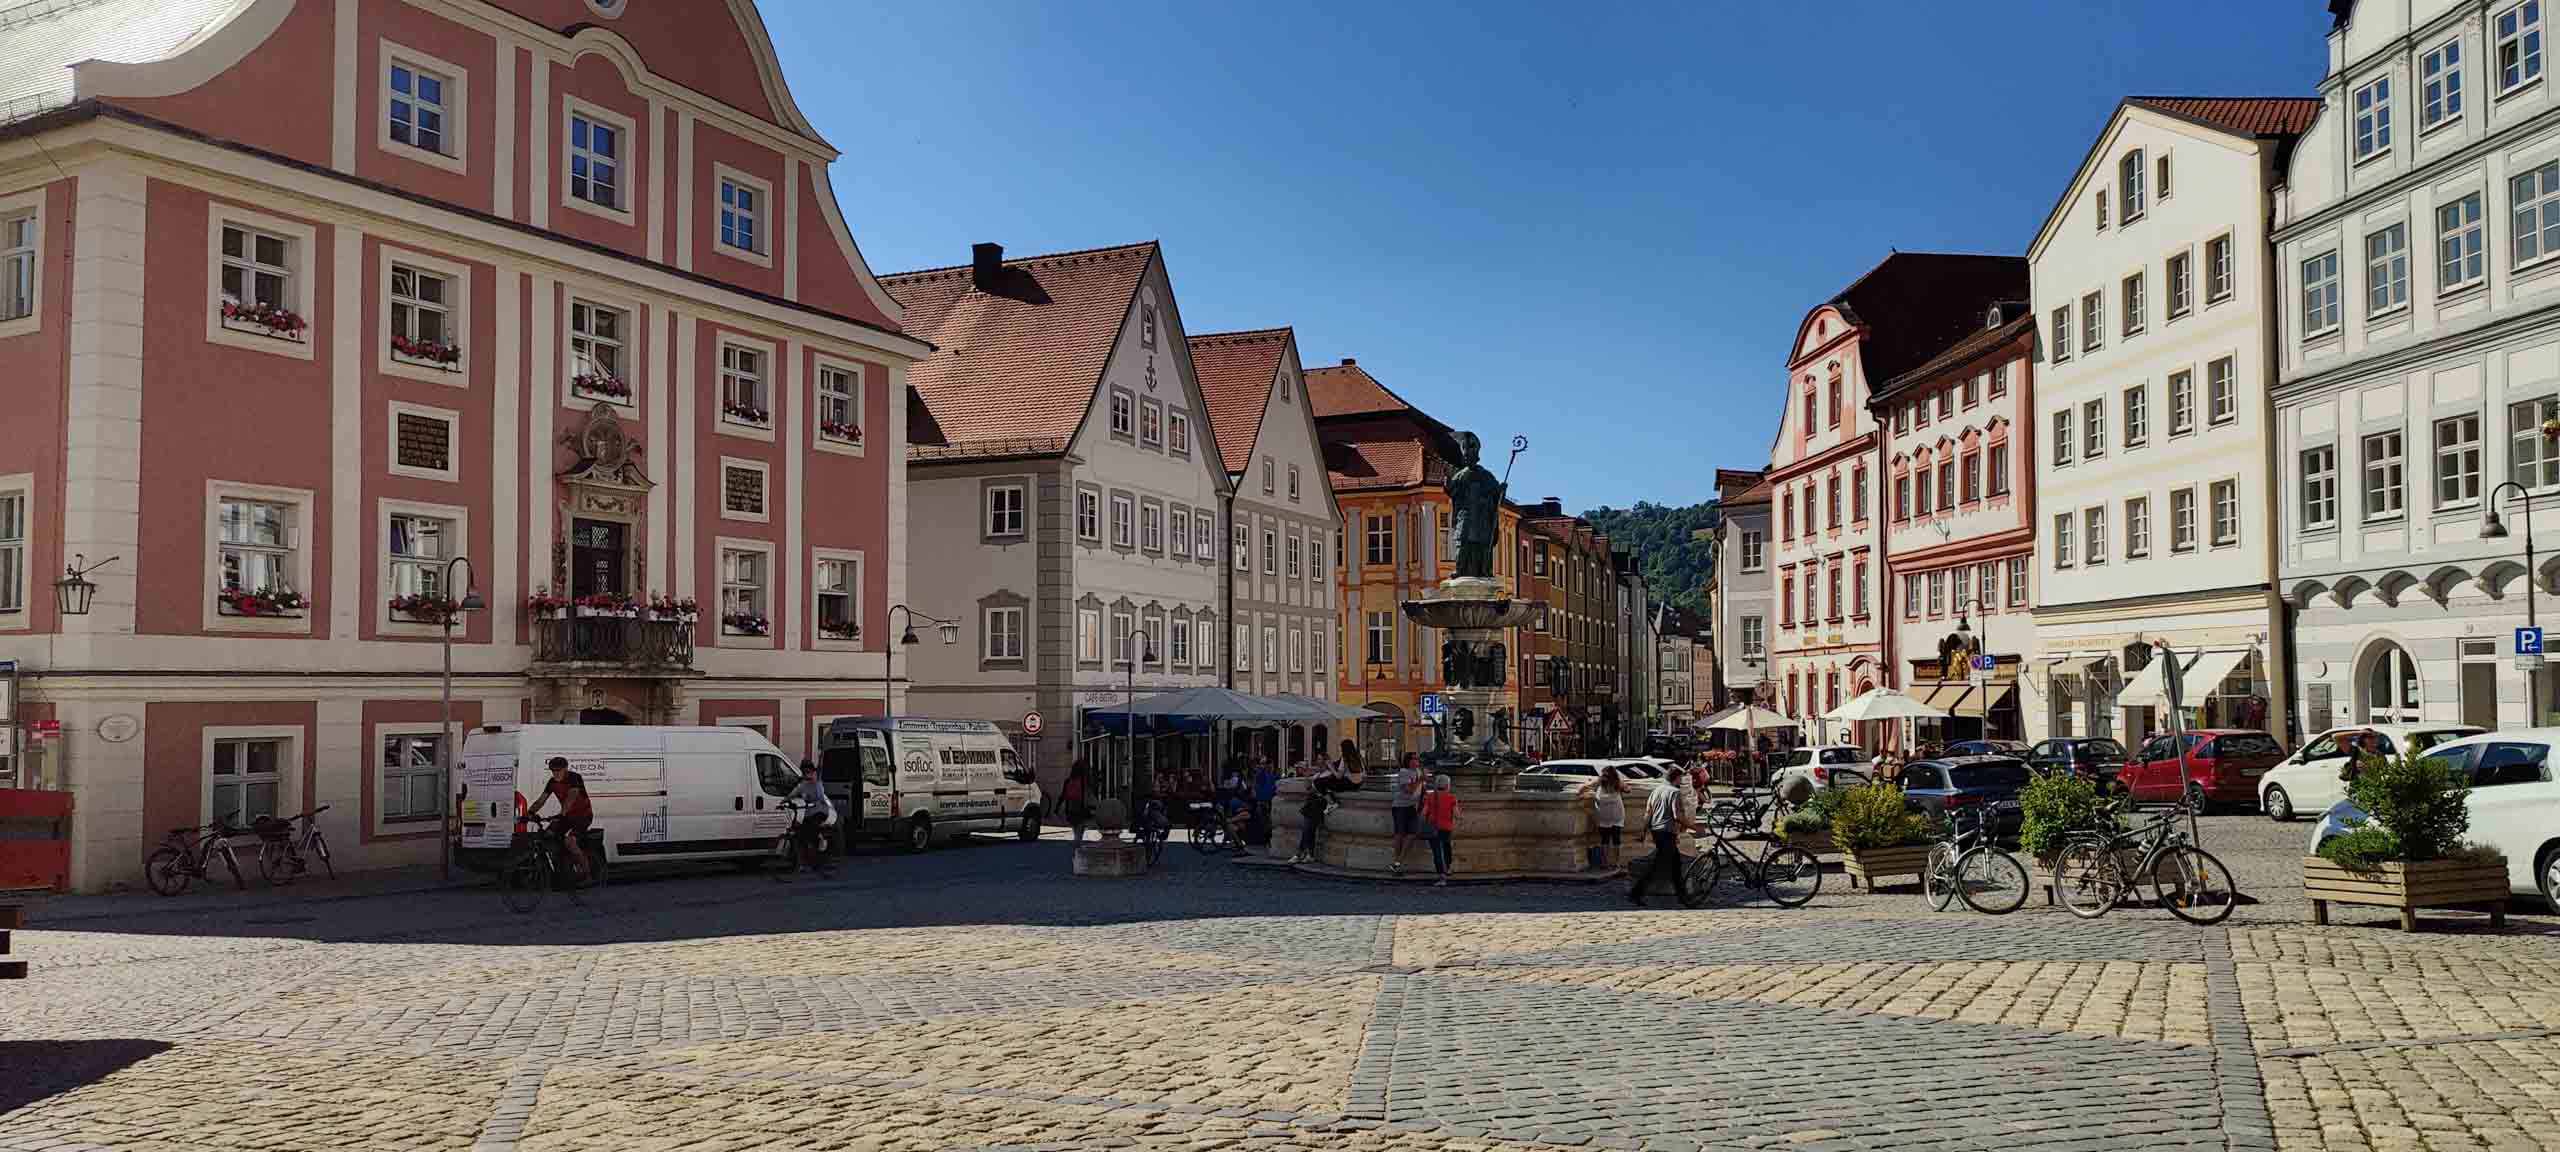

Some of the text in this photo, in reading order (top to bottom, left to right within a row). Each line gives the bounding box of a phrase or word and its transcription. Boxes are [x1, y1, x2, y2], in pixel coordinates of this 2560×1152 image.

[2521, 630, 2537, 651] P
[1984, 656, 1992, 668] P
[1423, 696, 1432, 711] P
